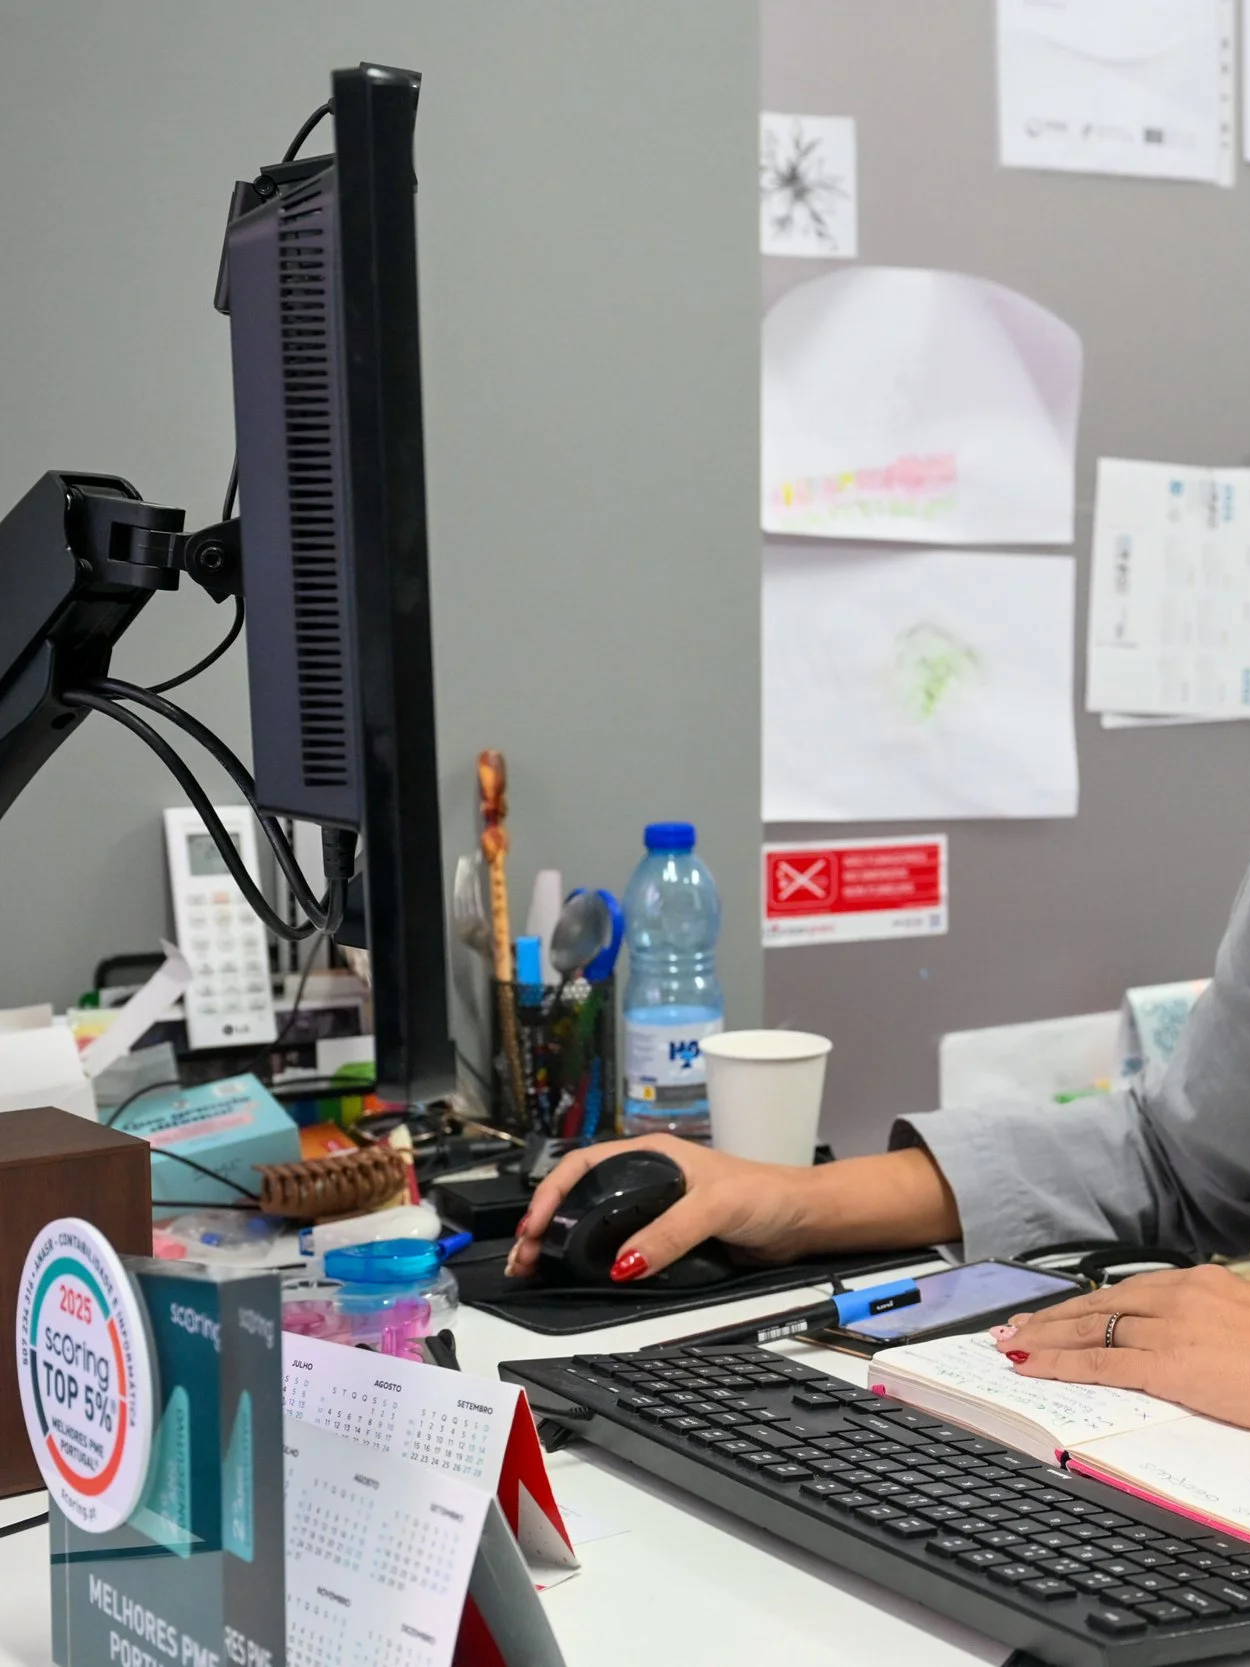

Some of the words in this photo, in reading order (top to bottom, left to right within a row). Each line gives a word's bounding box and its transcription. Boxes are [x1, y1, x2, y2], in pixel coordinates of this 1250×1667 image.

[60, 1284, 93, 1325] 2025
[876, 1300, 894, 1311] uni
[292, 1359, 313, 1371] JULHO
[43, 1360, 78, 1410] TOP
[374, 1379, 402, 1393] AGOSTO
[457, 1399, 493, 1415] SETEMBRO
[52, 1416, 88, 1448] MELHORES
[89, 1438, 104, 1459] PME
[410, 1452, 419, 1461] 22
[420, 1455, 429, 1463] 23
[431, 1457, 439, 1465] 24
[441, 1461, 450, 1469] 25
[452, 1463, 461, 1472] 26
[89, 1573, 178, 1659] MELHORES
[182, 1634, 219, 1667] PME
